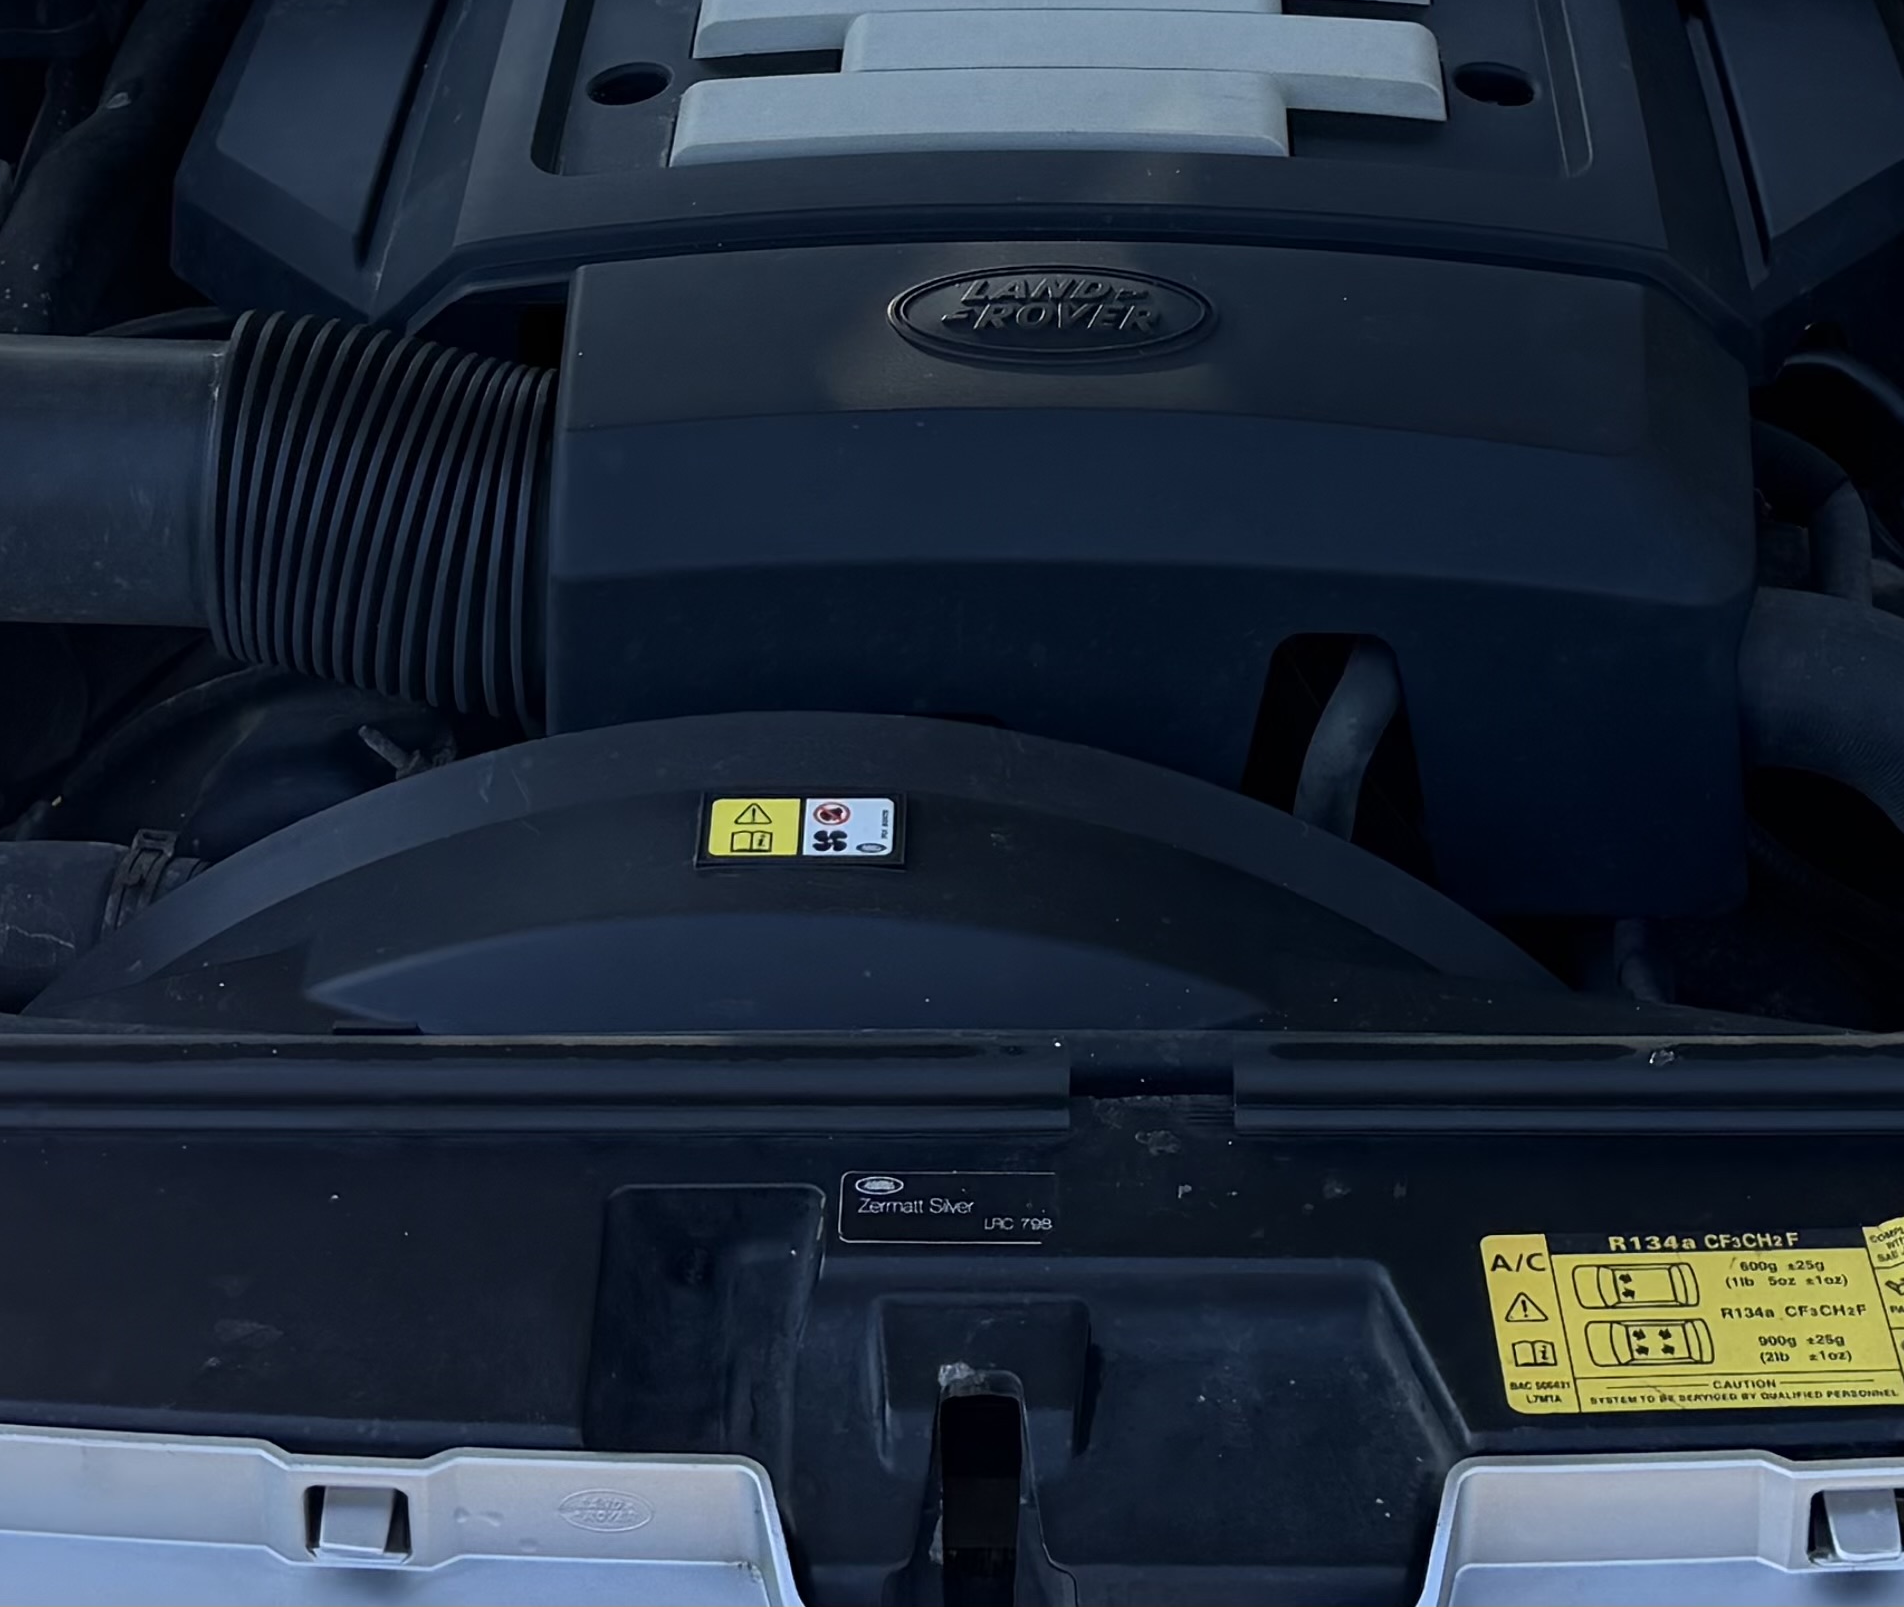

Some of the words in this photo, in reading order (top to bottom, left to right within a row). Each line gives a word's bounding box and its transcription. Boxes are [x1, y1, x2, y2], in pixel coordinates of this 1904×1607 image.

[959, 273, 1116, 303] LAND
[972, 302, 1158, 332] ROVER
[857, 1197, 925, 1215] Zermatt
[928, 1197, 976, 1215] Silver
[1020, 1216, 1053, 1231] 798
[1608, 1235, 1697, 1252] R134a
[1490, 1252, 1547, 1273] A/C
[1876, 1249, 1899, 1263] SAE
[1739, 1260, 1779, 1274] 600g
[1788, 1259, 1825, 1273] ±25g
[1725, 1275, 1755, 1290] (1lb
[1767, 1275, 1797, 1287] 5oz
[1805, 1273, 1849, 1288] ±1oz)
[1720, 1306, 1776, 1320] R134a
[1784, 1303, 1867, 1318] CF3CH2F
[1757, 1334, 1797, 1348] 900g
[1806, 1333, 1846, 1347] ±25g
[1759, 1350, 1790, 1365] (2lb
[1808, 1349, 1853, 1363] ±1oz)
[1712, 1378, 1778, 1391] CAUTION
[1590, 1395, 1639, 1406] SYSTEM
[1640, 1394, 1657, 1404] TO
[1659, 1394, 1676, 1404] BE
[1678, 1392, 1739, 1404] SERVICED
[1740, 1391, 1757, 1402] BY
[1760, 1390, 1824, 1402] QUALIFIED
[1826, 1388, 1900, 1401] PERSONNEL
